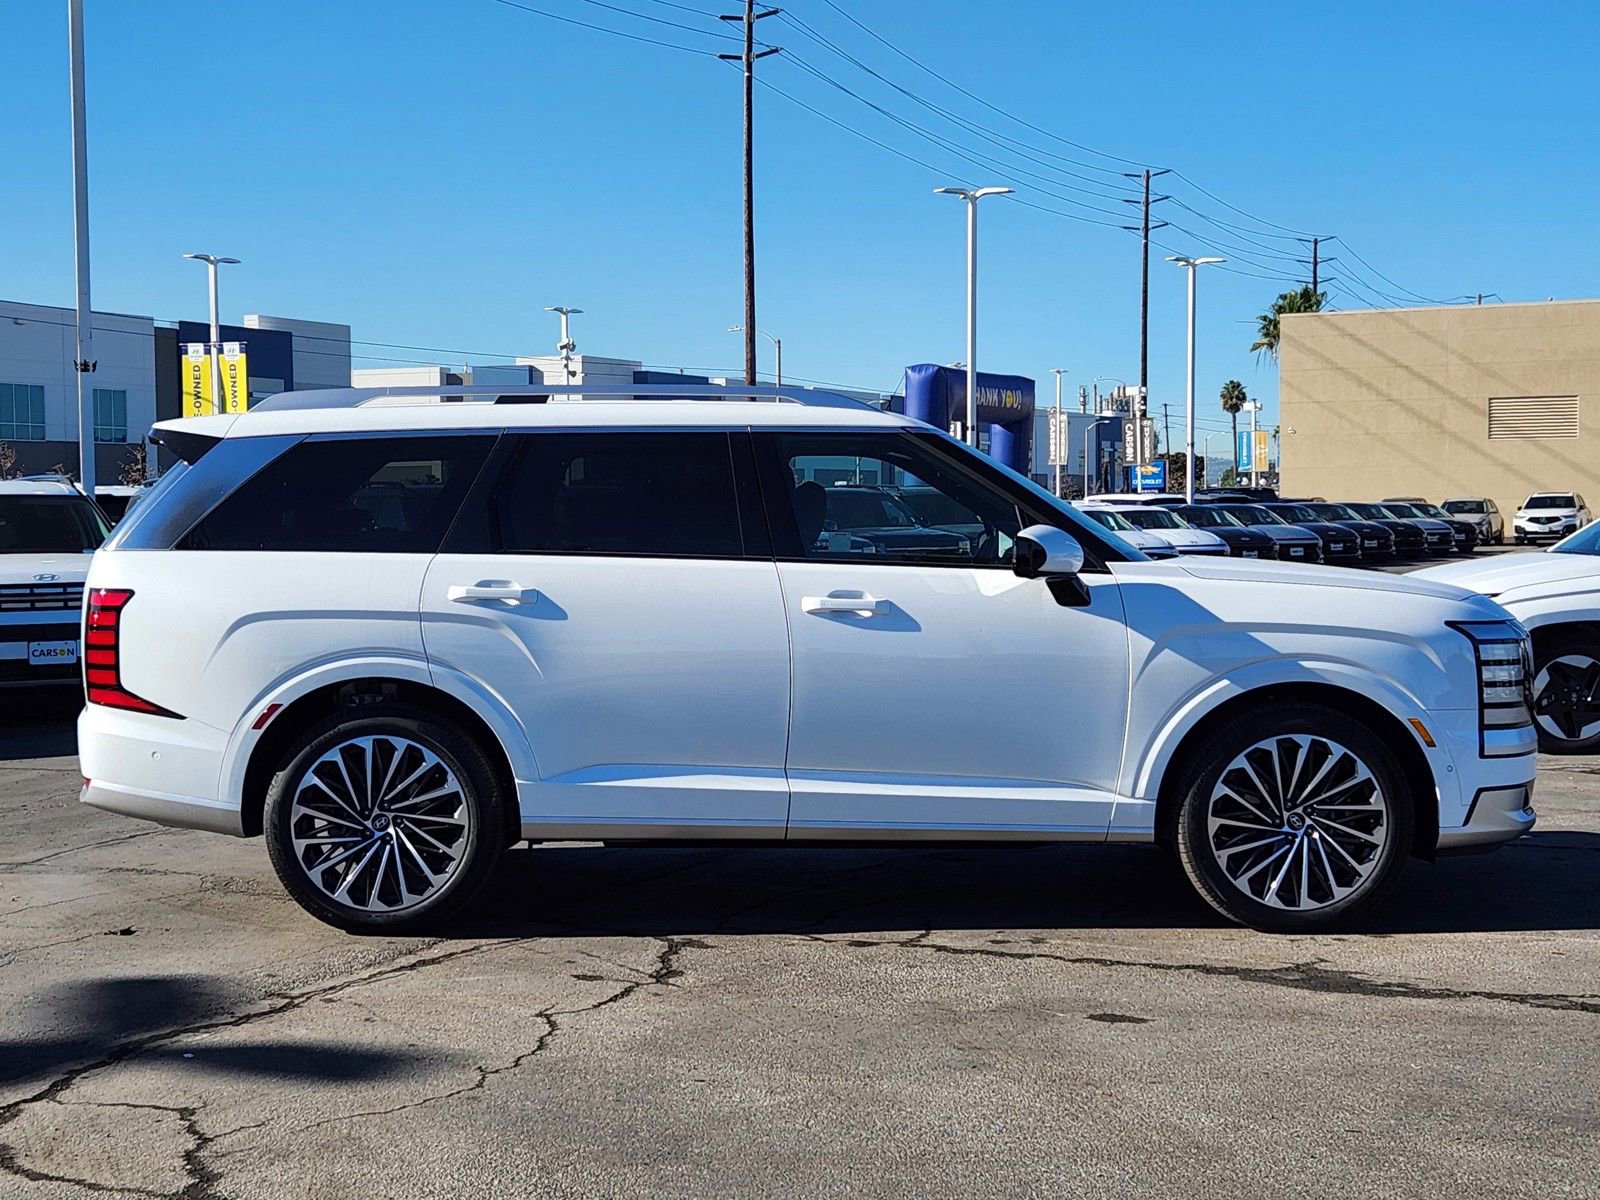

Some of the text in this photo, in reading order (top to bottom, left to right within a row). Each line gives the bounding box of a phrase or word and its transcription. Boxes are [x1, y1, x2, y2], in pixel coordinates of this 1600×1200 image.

[976, 386, 999, 407] HANK
[1124, 423, 1134, 461] CARSON
[31, 648, 74, 657] CARSON
